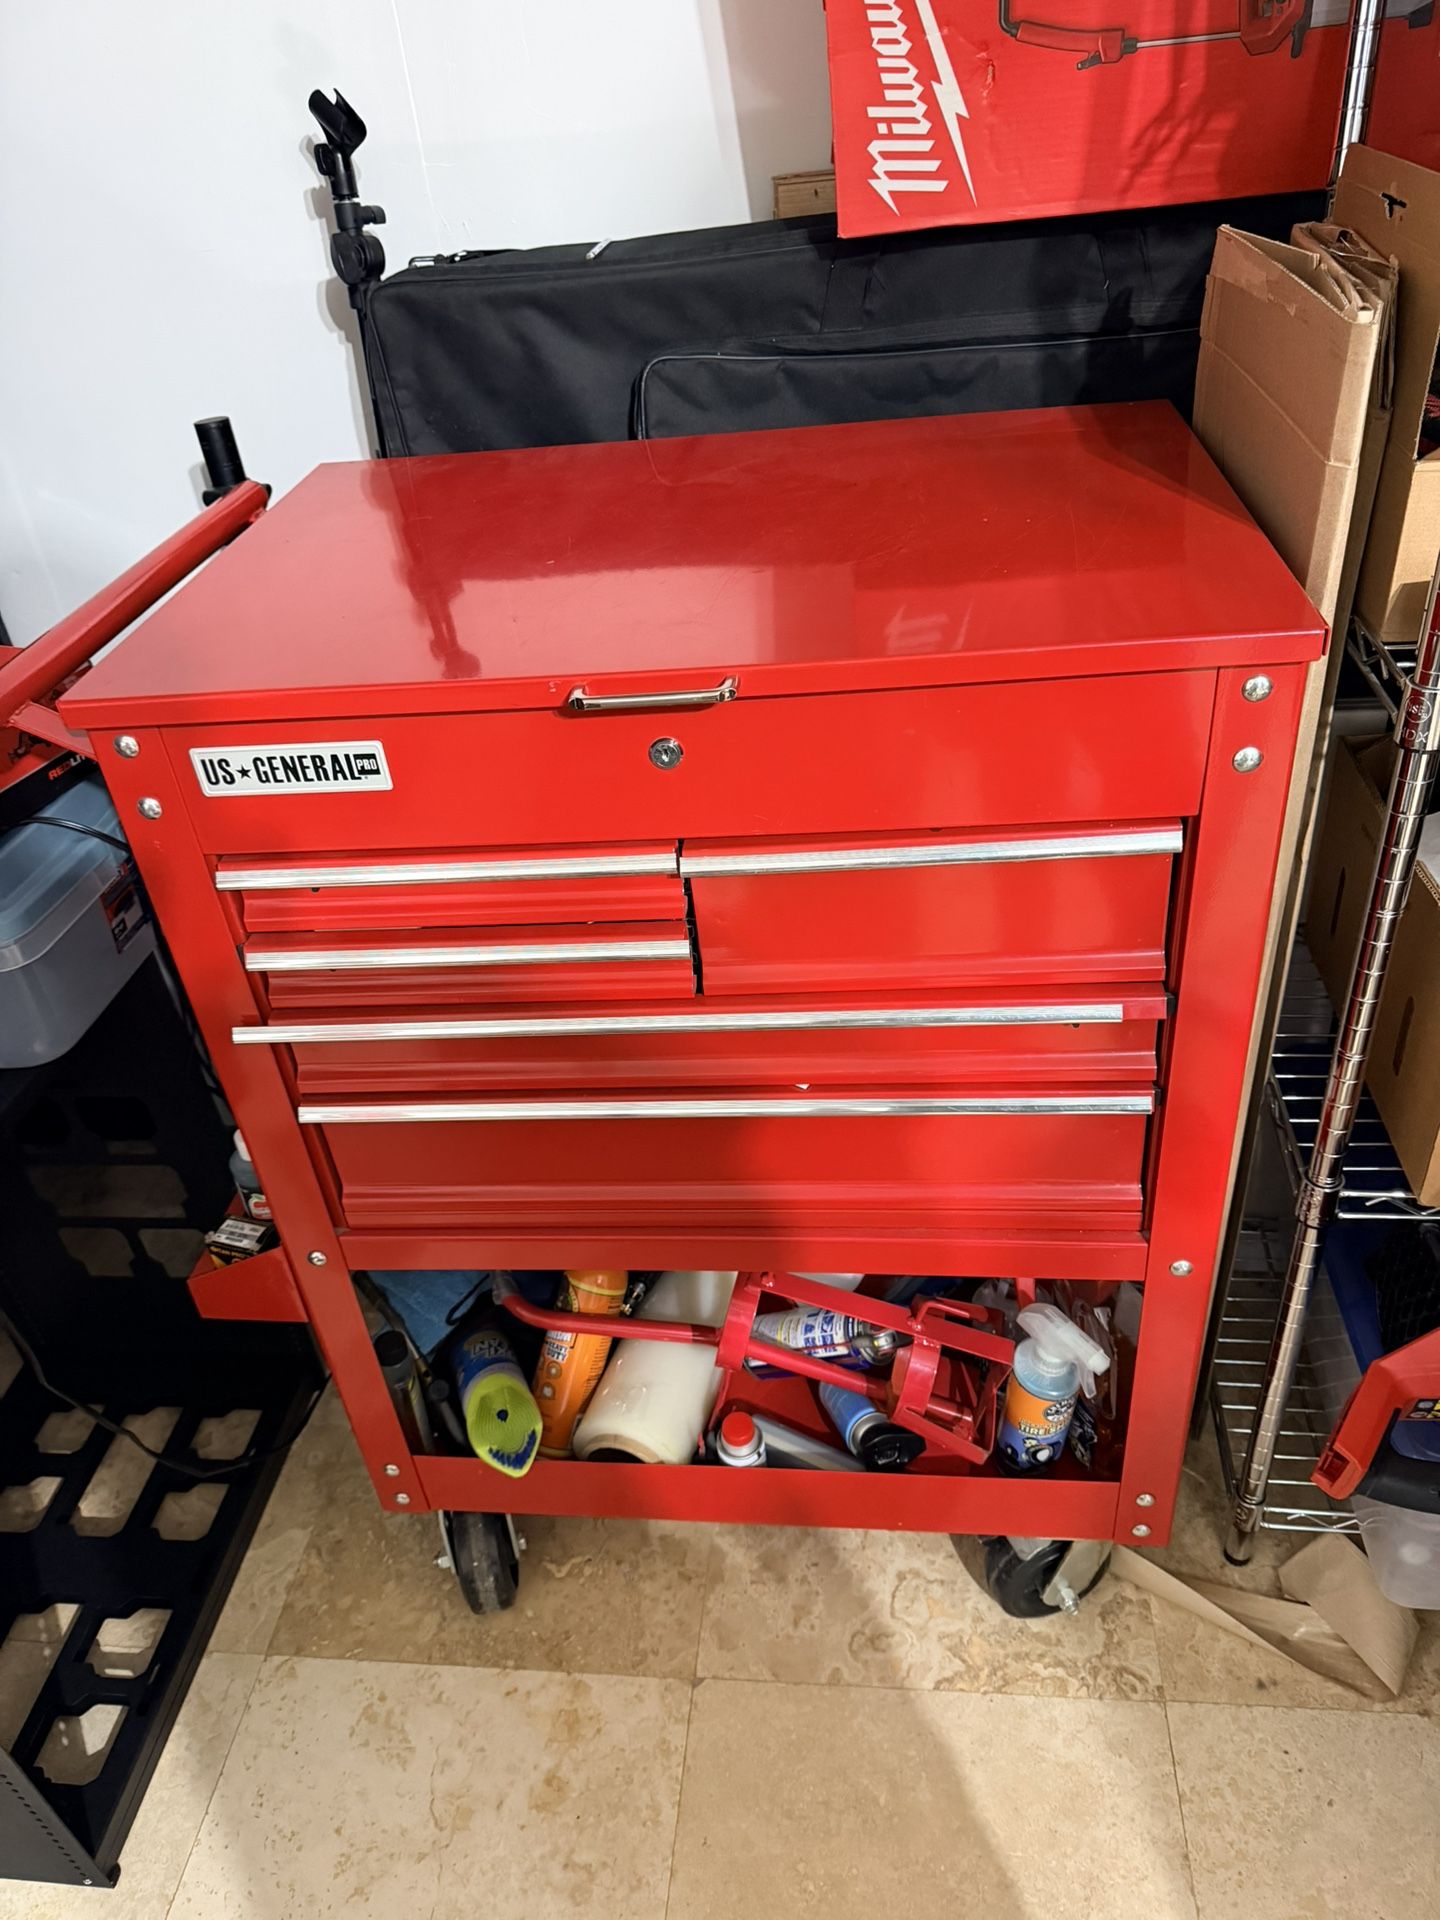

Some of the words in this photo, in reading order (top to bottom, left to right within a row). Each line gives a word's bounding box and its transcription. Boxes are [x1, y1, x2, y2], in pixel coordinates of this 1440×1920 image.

[201, 758, 236, 785] US
[252, 753, 361, 784] GENERAL
[355, 757, 378, 772] PRO
